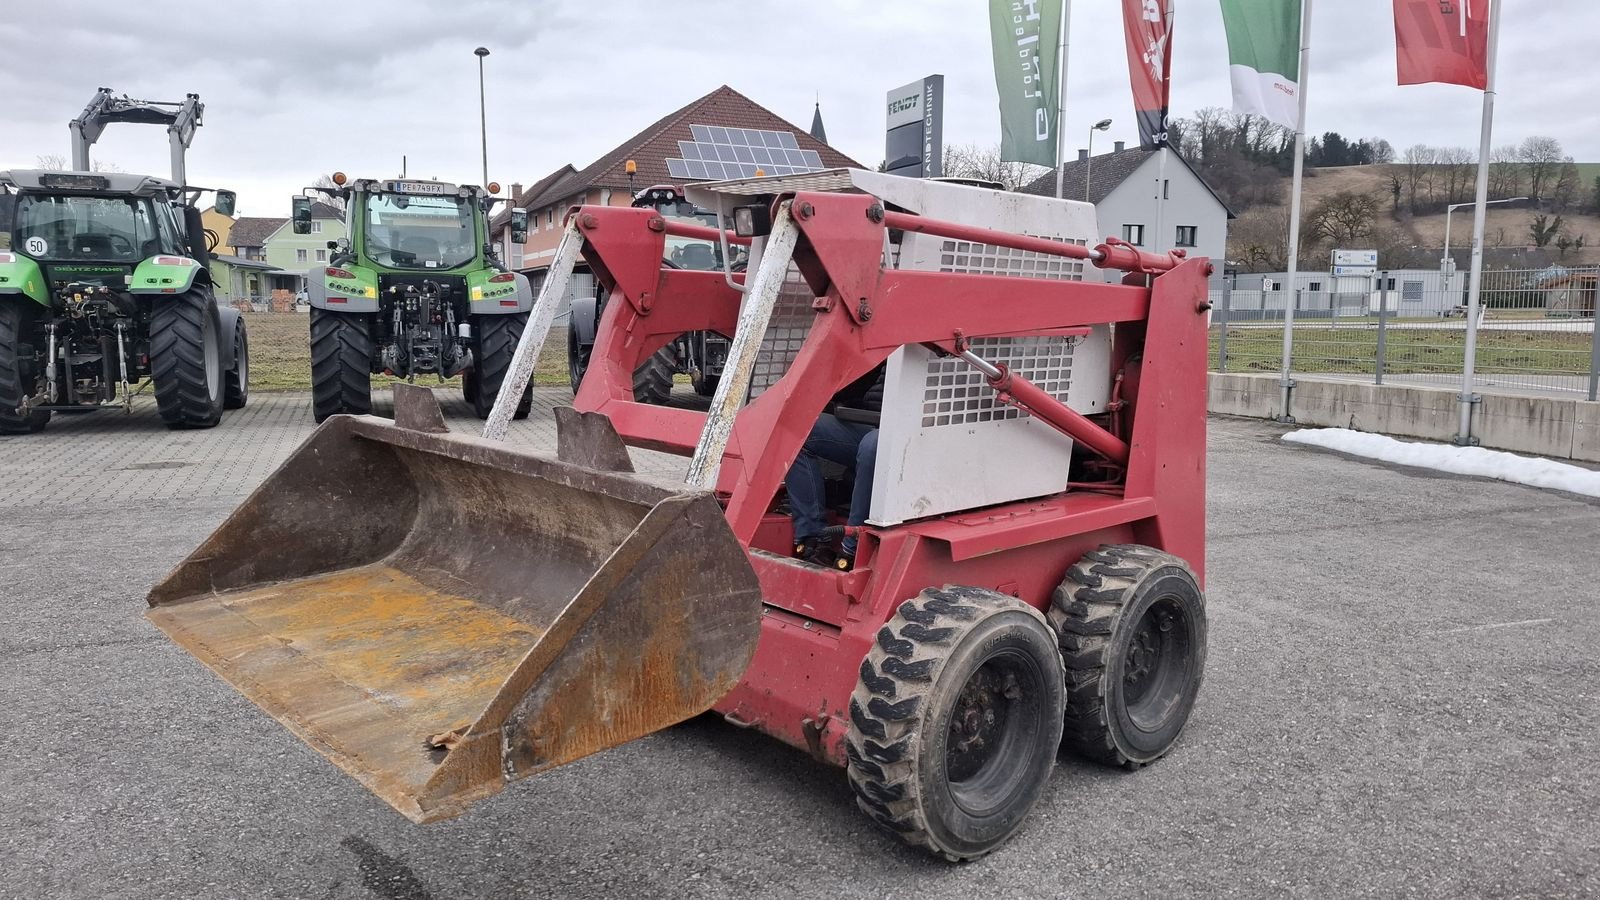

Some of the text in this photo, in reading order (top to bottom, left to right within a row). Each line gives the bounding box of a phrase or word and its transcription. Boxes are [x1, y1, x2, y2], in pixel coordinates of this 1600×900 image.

[888, 93, 920, 115] FENDT
[925, 83, 933, 179] ANDTECHNIK
[30, 240, 43, 252] 50
